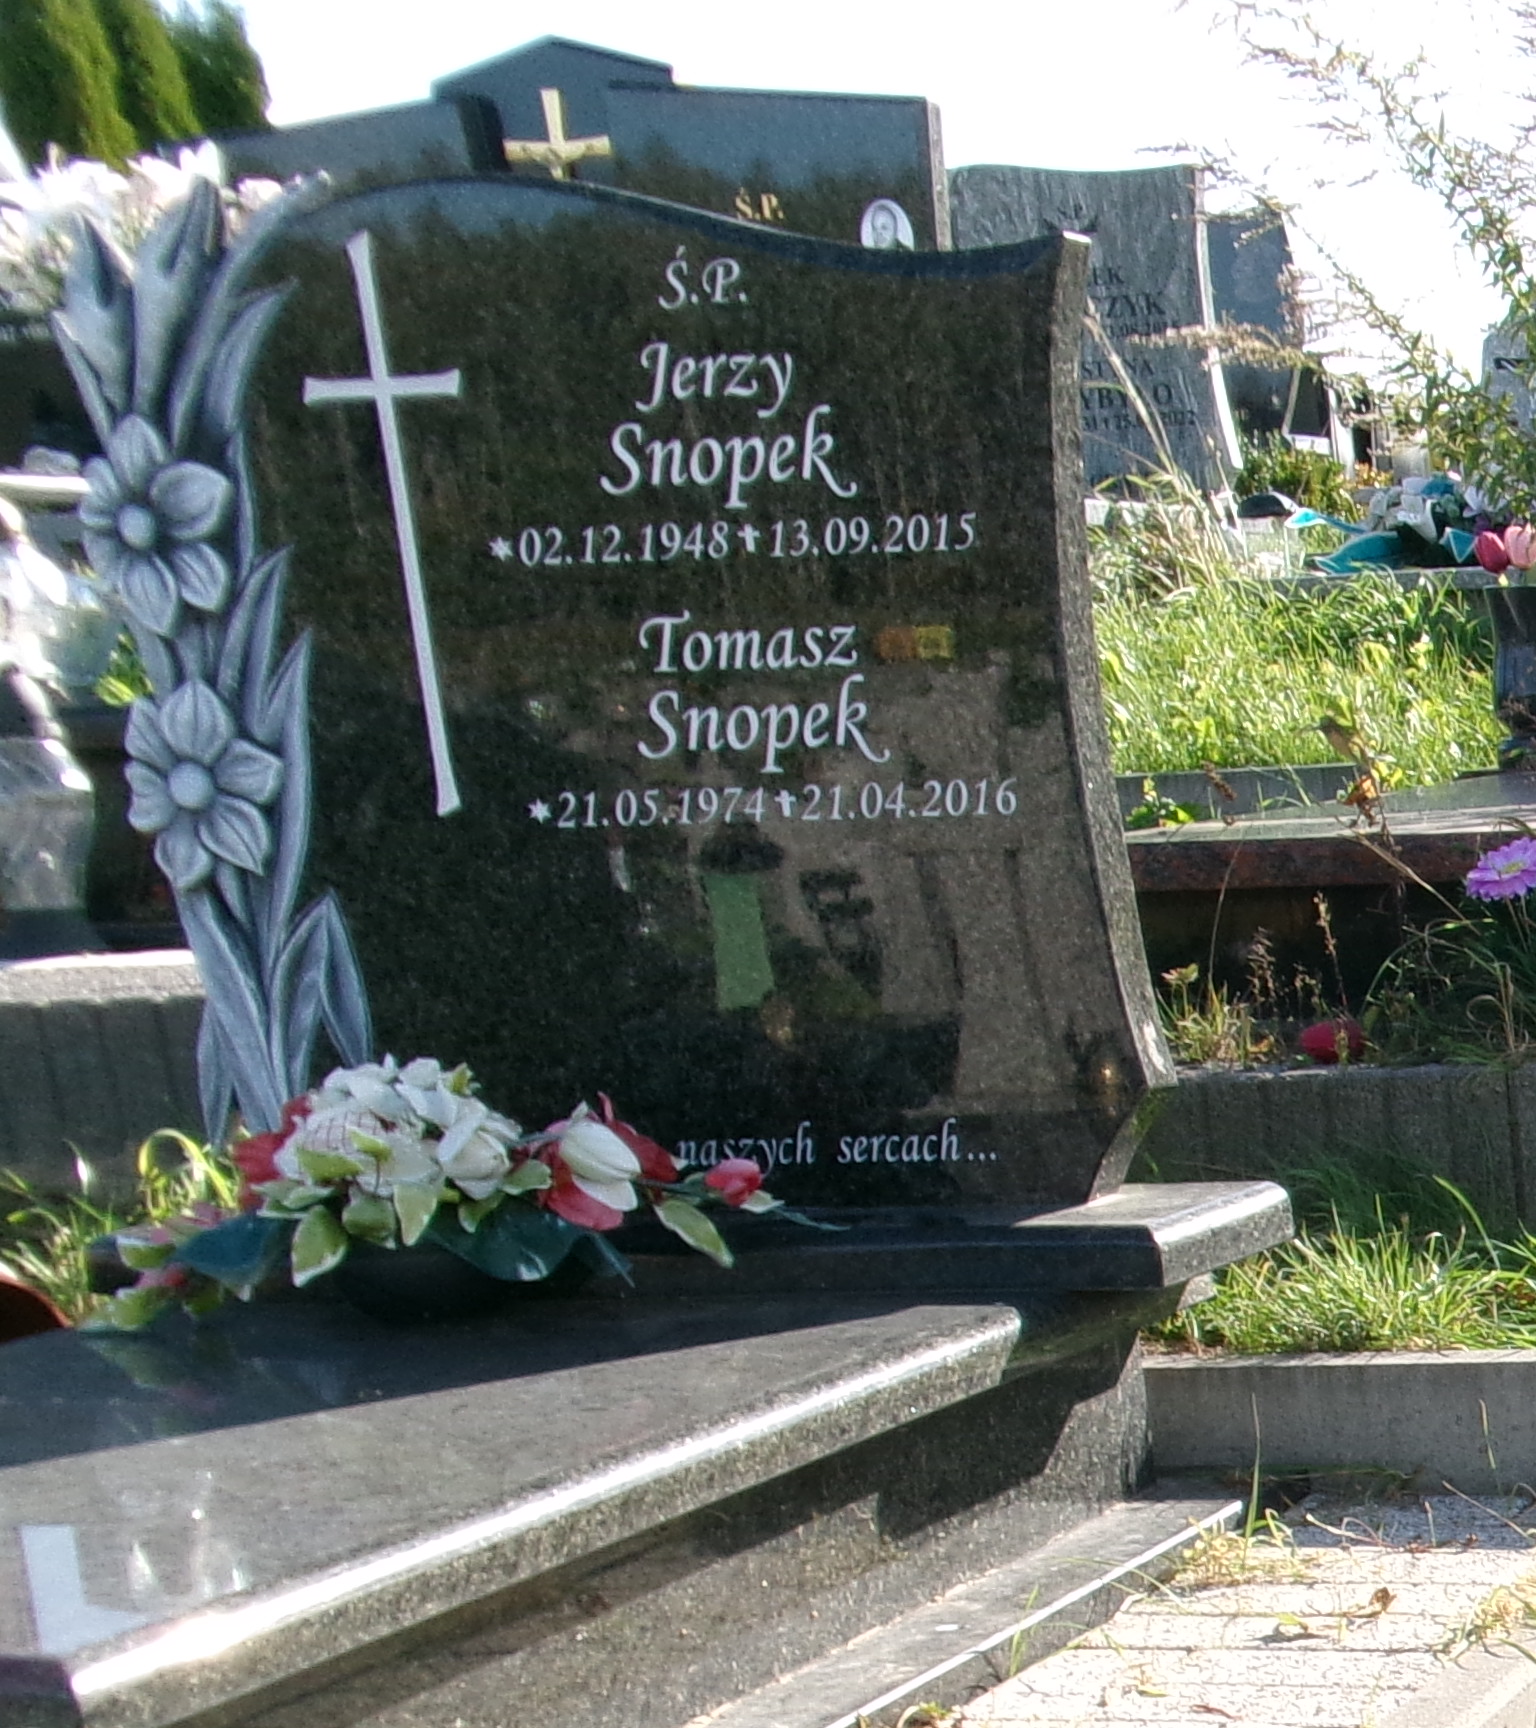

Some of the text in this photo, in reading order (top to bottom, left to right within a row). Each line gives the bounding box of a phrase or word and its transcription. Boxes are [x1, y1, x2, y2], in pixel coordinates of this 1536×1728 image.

[657, 246, 749, 310] Ś.P.
[634, 342, 793, 418] Jerzy
[600, 404, 858, 509] Snopek
[518, 512, 976, 567] 02.12.1948 13.09.2015
[637, 610, 858, 672] Tomasz
[637, 674, 890, 773] Snopek
[557, 778, 1018, 829] 21.05.1974 21.04.2016
[677, 1117, 998, 1177] naszych sercach...
